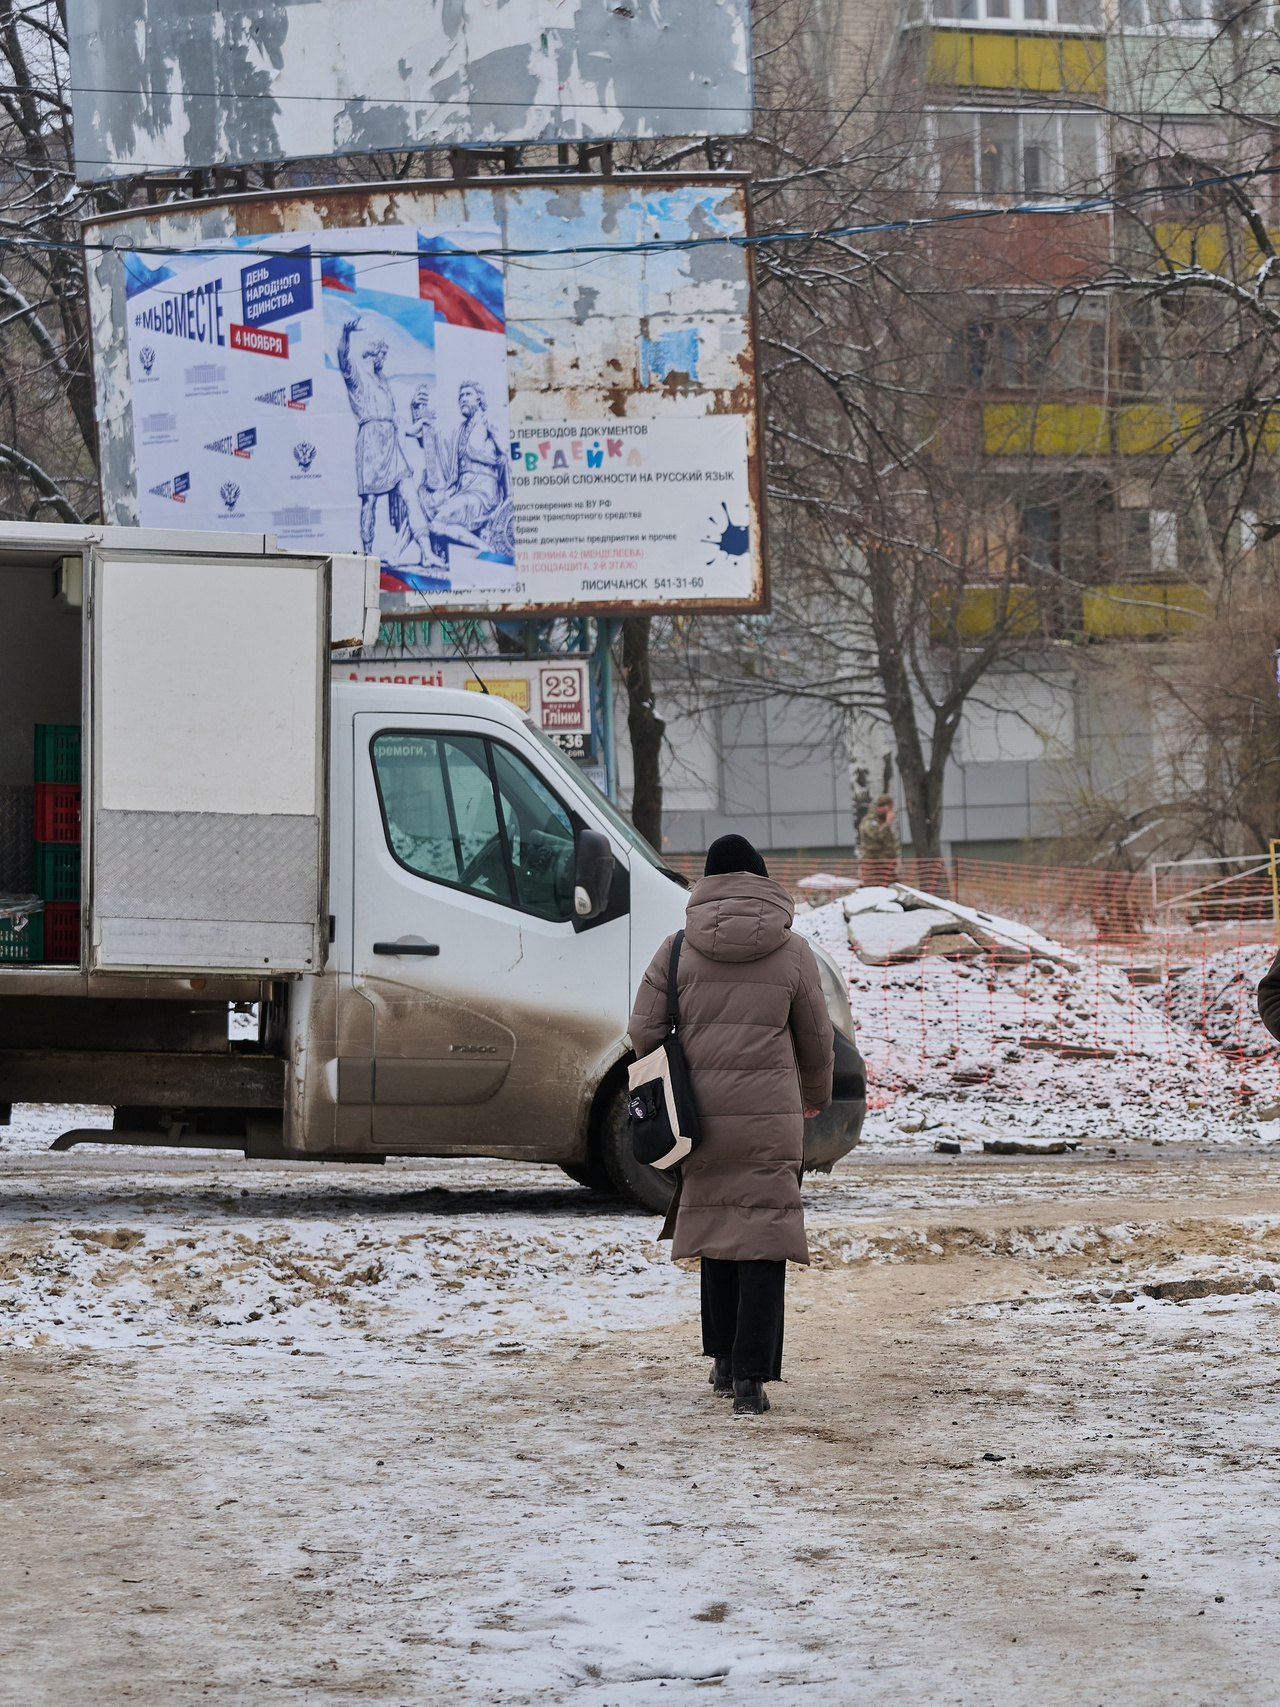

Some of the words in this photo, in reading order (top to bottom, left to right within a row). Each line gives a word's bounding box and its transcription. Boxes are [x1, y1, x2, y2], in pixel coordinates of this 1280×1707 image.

[246, 266, 270, 287] ДЕНЬ
[246, 272, 301, 303] НАРОДНОГО
[134, 277, 226, 348] #МЫВМЕСТЕ
[247, 291, 295, 320] ЕДИНСТВА
[235, 330, 242, 347] 4
[243, 333, 283, 354] НОЯБРЯ
[518, 427, 578, 439] ПЕРЕВОДОВ
[580, 425, 648, 438] ДОКУМЕНТОВ
[533, 473, 570, 486] ЛЮБОЙ
[573, 473, 637, 485] СЛОЖНОСТИ
[640, 472, 653, 483] НА
[656, 470, 702, 482] РУССКИЙ
[705, 470, 735, 481] ЯЗЫК
[586, 500, 597, 509] ВУ
[599, 499, 612, 508] РФ
[543, 513, 603, 522] транспортного
[605, 511, 642, 520] средства
[540, 537, 584, 546] документы
[587, 535, 639, 544] предприятия
[649, 534, 677, 542] прочее
[533, 550, 566, 560] ЛЕНИНА
[569, 550, 578, 559] 42
[581, 548, 644, 560] (МЕНДЕЛЕЕВА)
[609, 560, 638, 571] ЭТАЖ)
[581, 579, 648, 591] ЛИСИЧАНСК
[654, 577, 704, 589] 541-31-60
[545, 676, 577, 698] 23
[542, 708, 581, 725] Глінки
